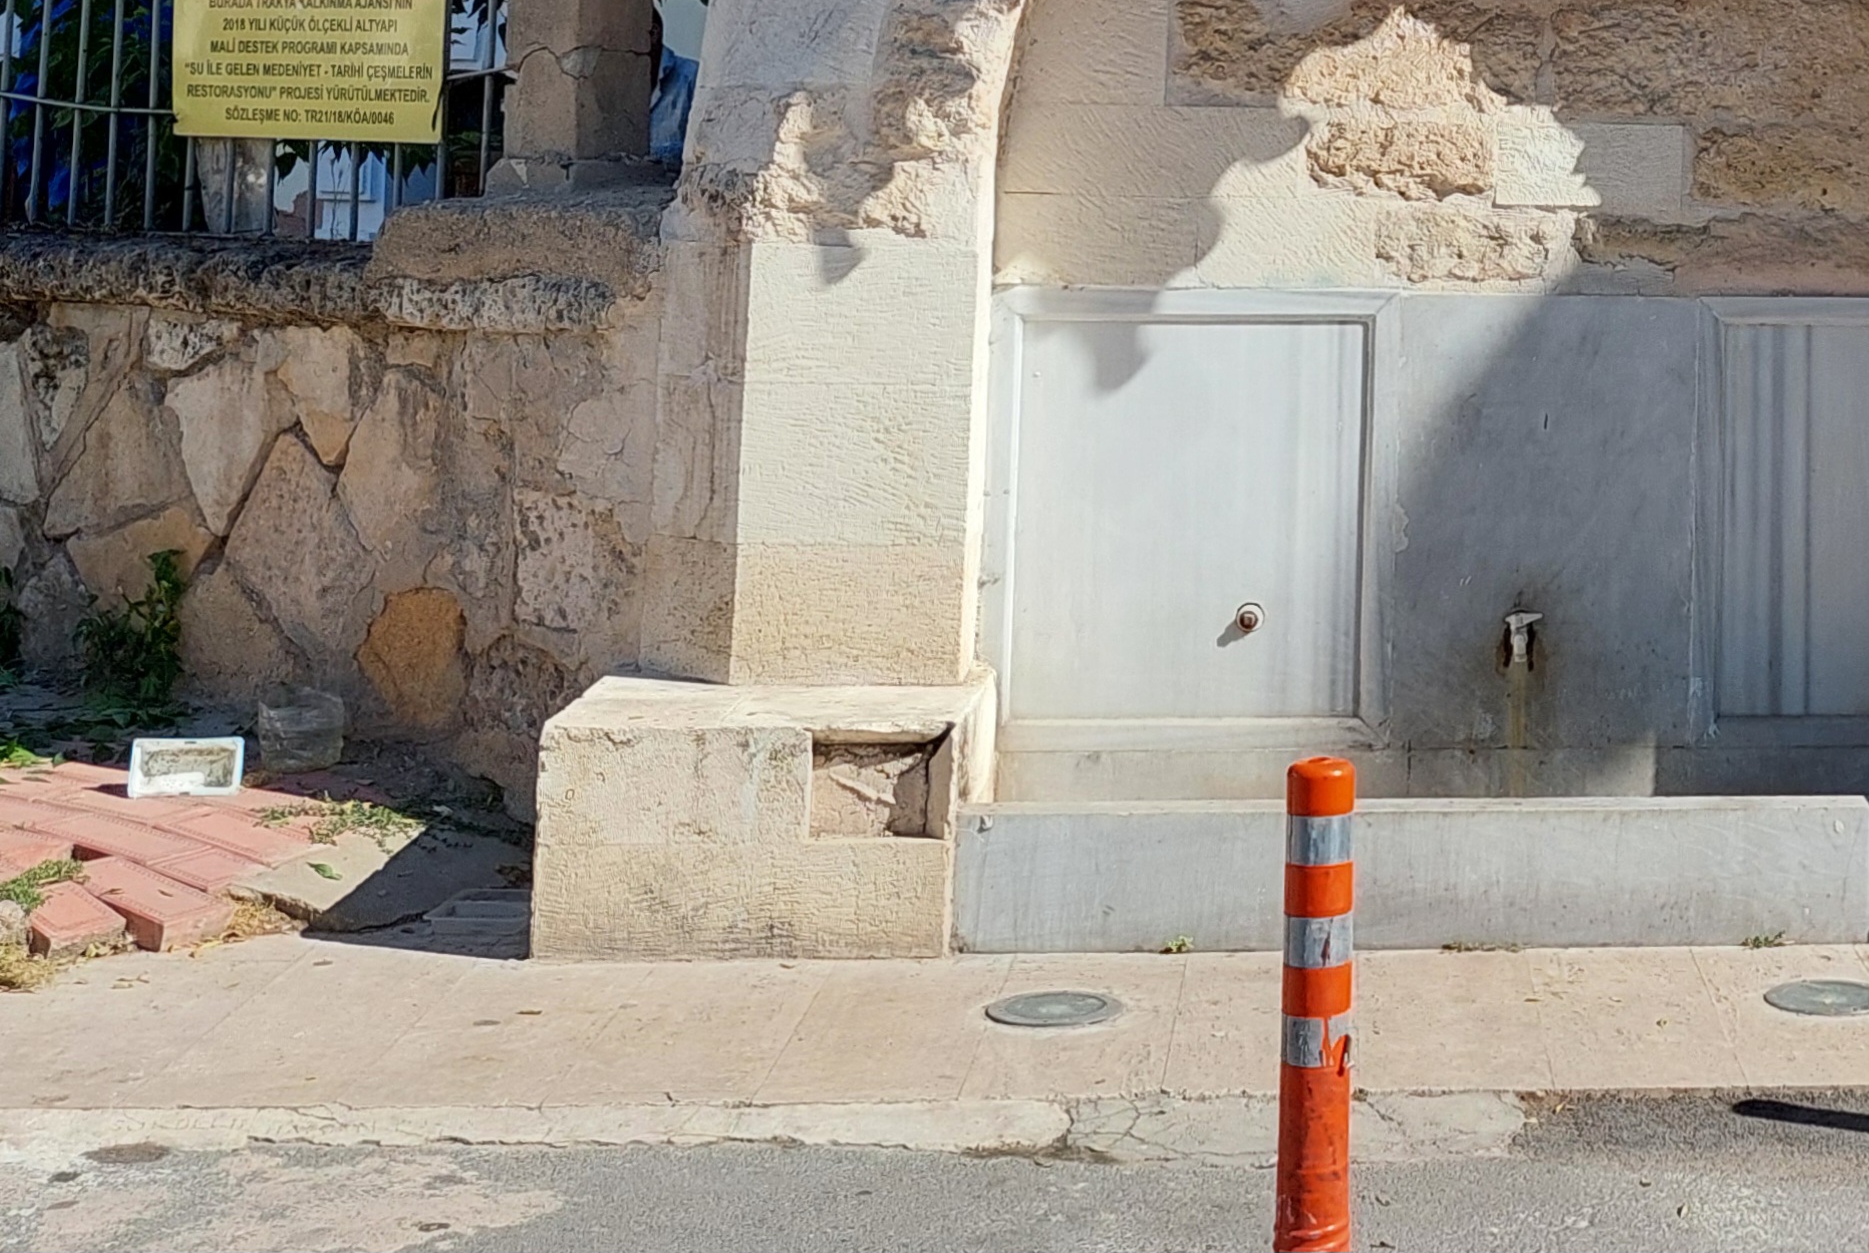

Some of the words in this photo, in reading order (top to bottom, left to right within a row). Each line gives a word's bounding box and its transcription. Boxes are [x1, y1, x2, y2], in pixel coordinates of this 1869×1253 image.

[222, 17, 245, 31] 2018
[250, 18, 267, 32] YILI
[269, 17, 306, 35] KÜÇÜK
[308, 15, 353, 35] ÖLÇEKLİ
[355, 19, 398, 33] ALTYAPI
[210, 37, 236, 53] MALİ
[238, 40, 279, 54] DESTEK
[282, 40, 338, 55] PROGRAMI
[340, 41, 409, 56] KAPSAMINDA
[206, 59, 223, 76] İLE
[226, 62, 259, 77] GELEN
[262, 61, 322, 78] MEDENİYET
[330, 61, 364, 79] TARİHİ
[366, 62, 433, 82] ÇEŞMELERİN
[280, 84, 324, 101] PROJESİ
[325, 85, 430, 103] YÜRÜTÜLMEKTEDİR.
[225, 105, 280, 124] SÖZLEŞME
[283, 109, 301, 123] NO:
[304, 108, 395, 125] TR21/18/KÖA/0046
